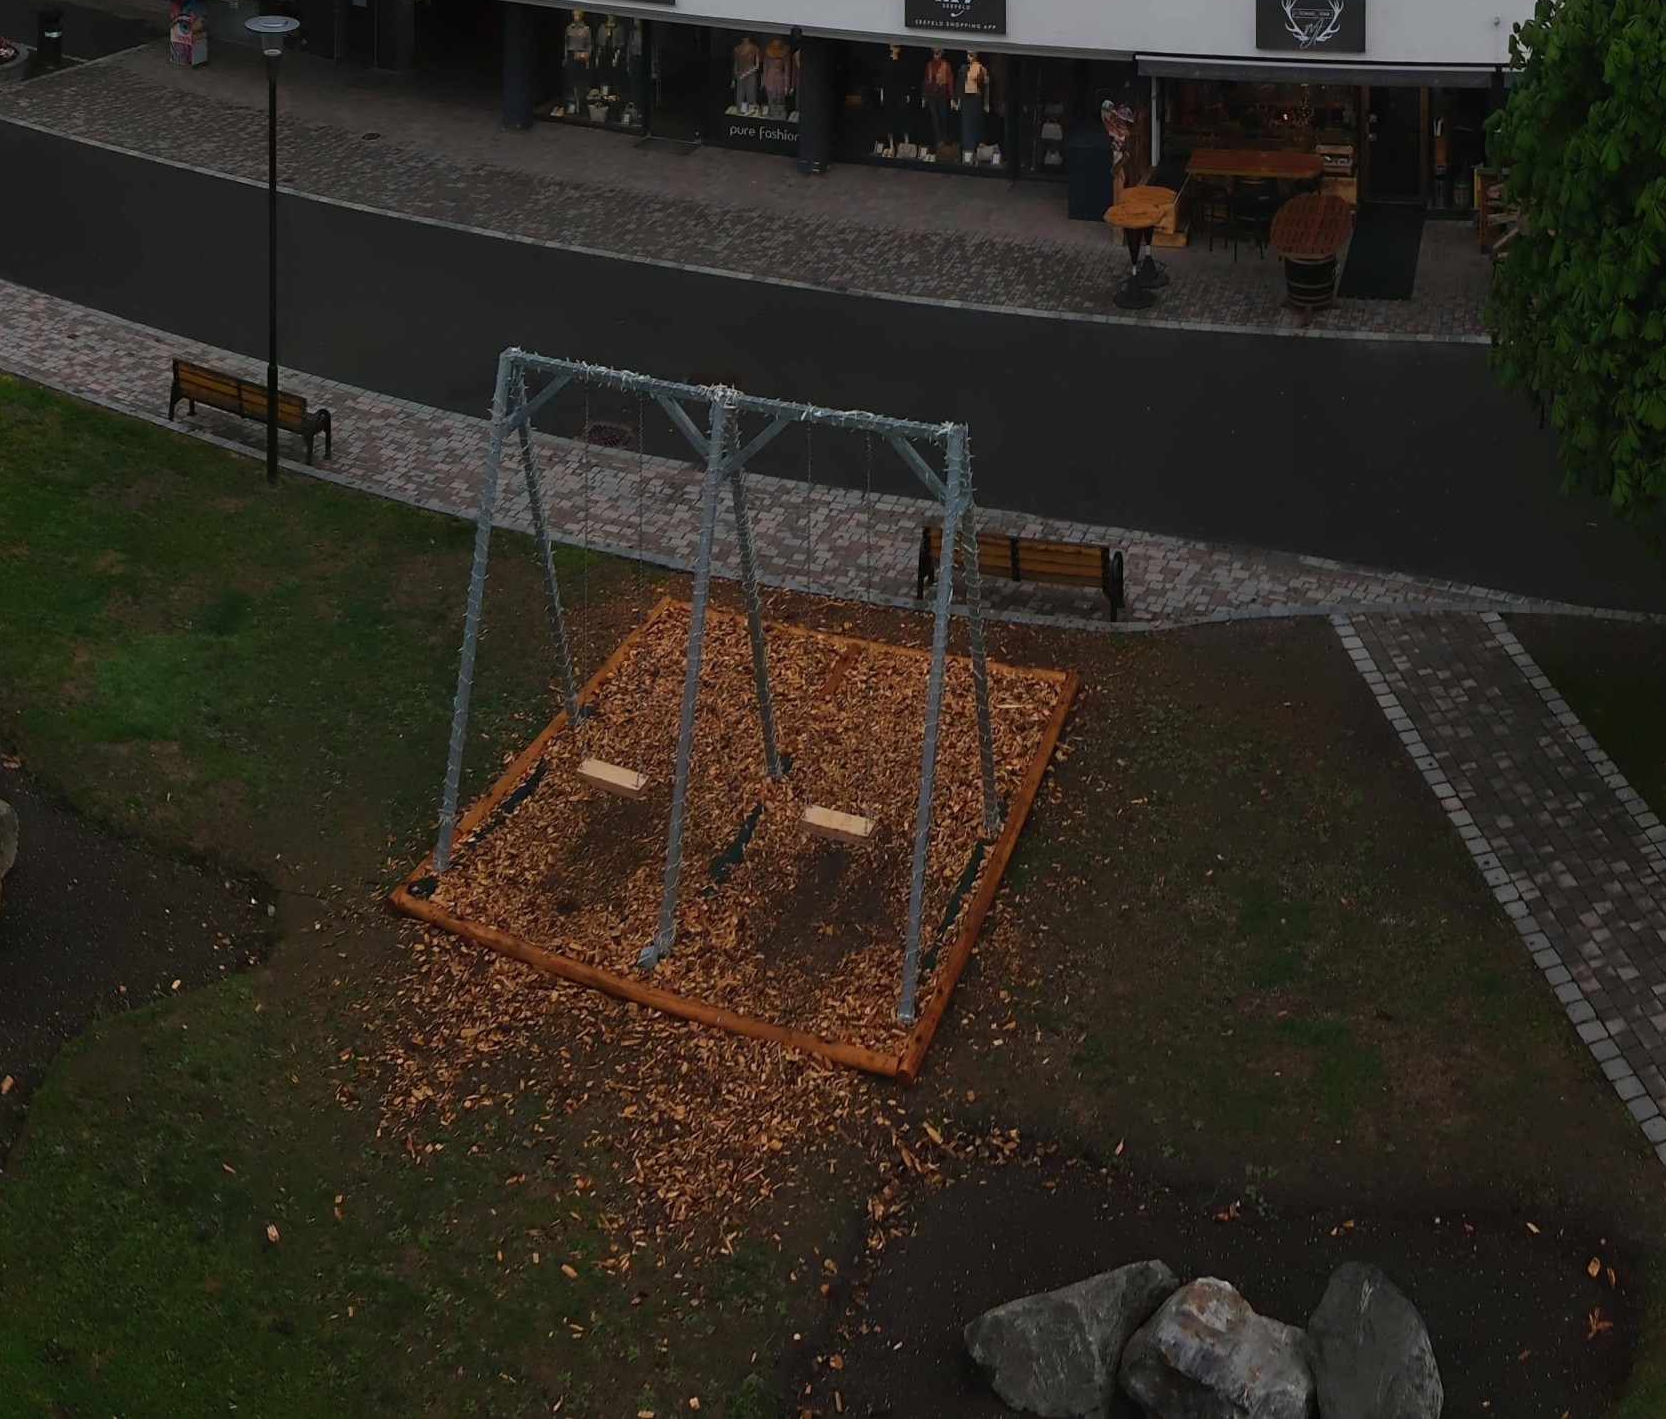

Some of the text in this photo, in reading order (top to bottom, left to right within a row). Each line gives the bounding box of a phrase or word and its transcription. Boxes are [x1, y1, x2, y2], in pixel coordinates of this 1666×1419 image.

[914, 19, 943, 27] SEEFELD
[946, 21, 981, 29] SHOPPING
[729, 125, 756, 137] pure
